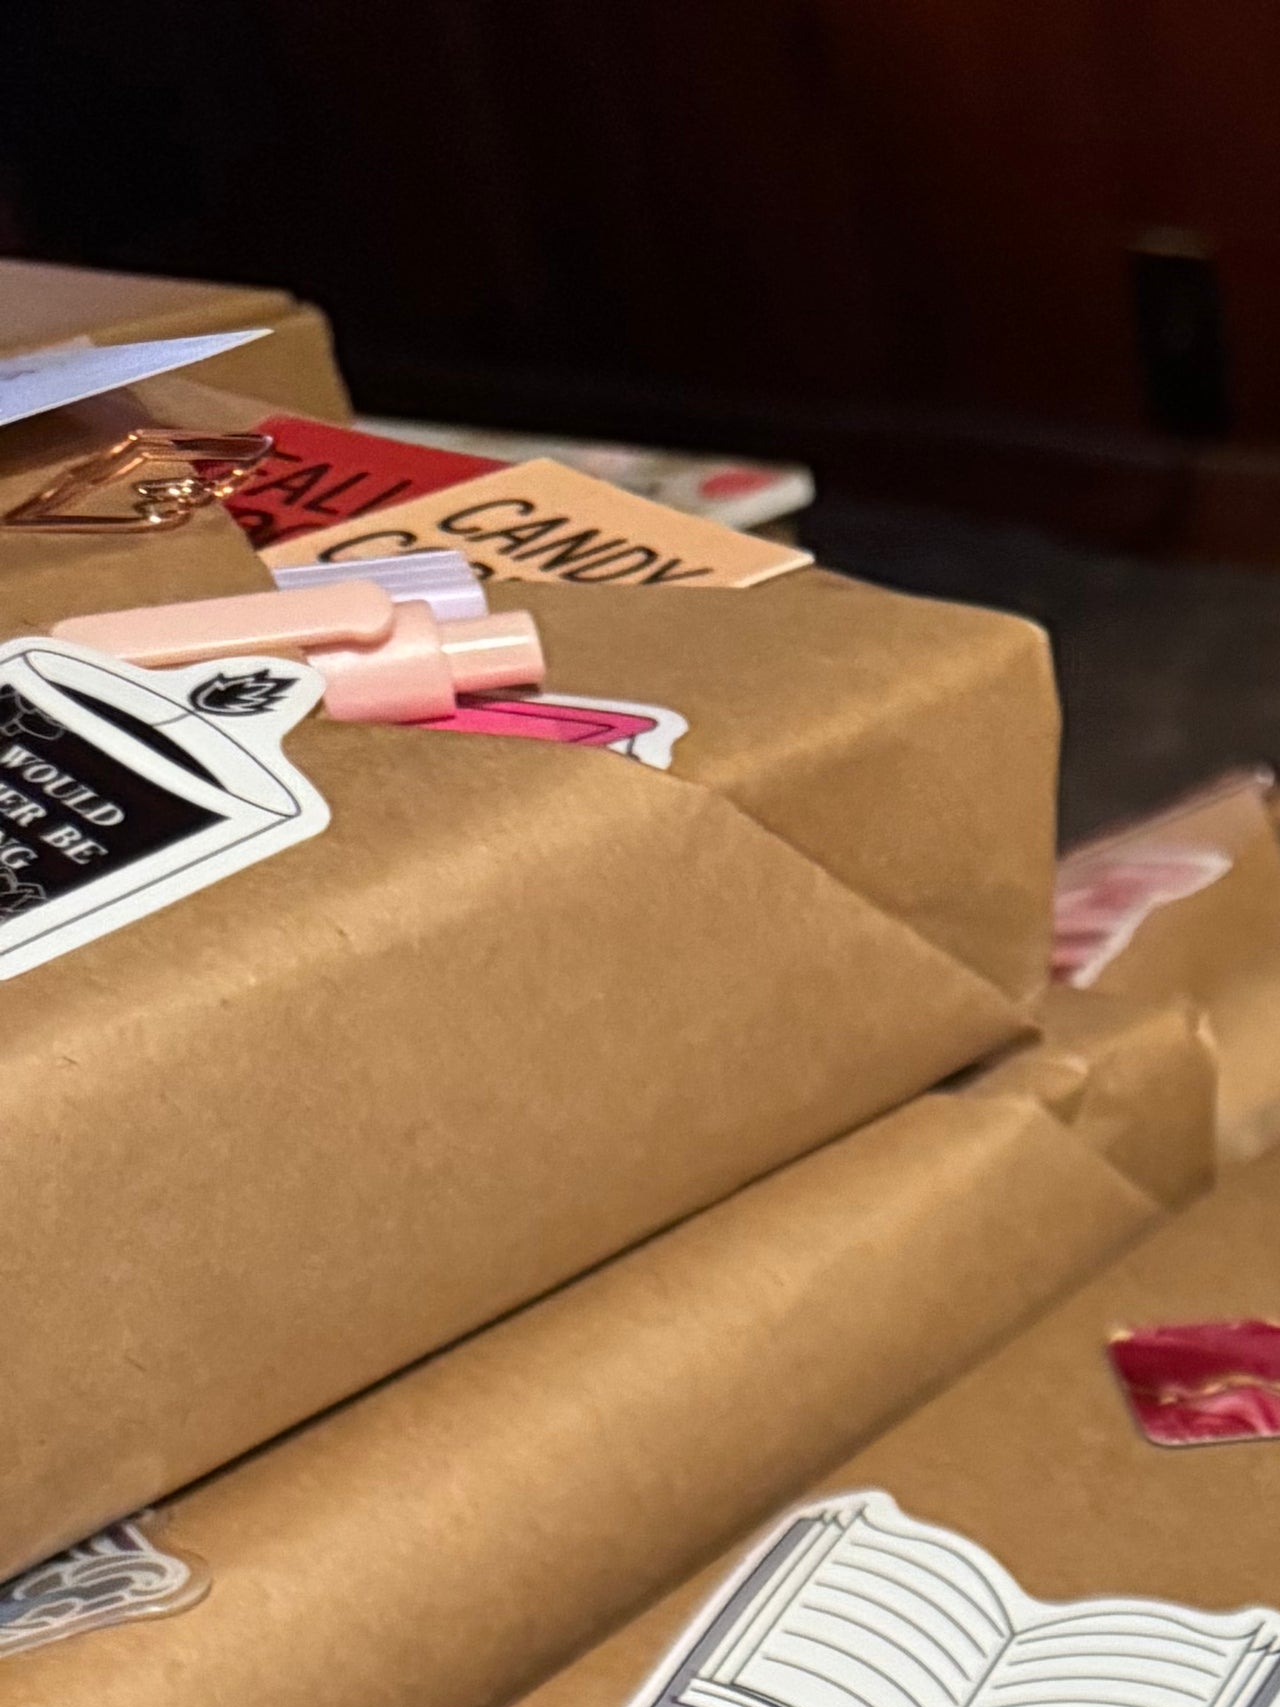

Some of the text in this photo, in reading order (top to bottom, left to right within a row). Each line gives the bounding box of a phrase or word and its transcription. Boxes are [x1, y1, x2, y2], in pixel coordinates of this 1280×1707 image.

[436, 497, 715, 586] CANDY
[0, 745, 125, 826] WOULD
[41, 825, 109, 865] BE
